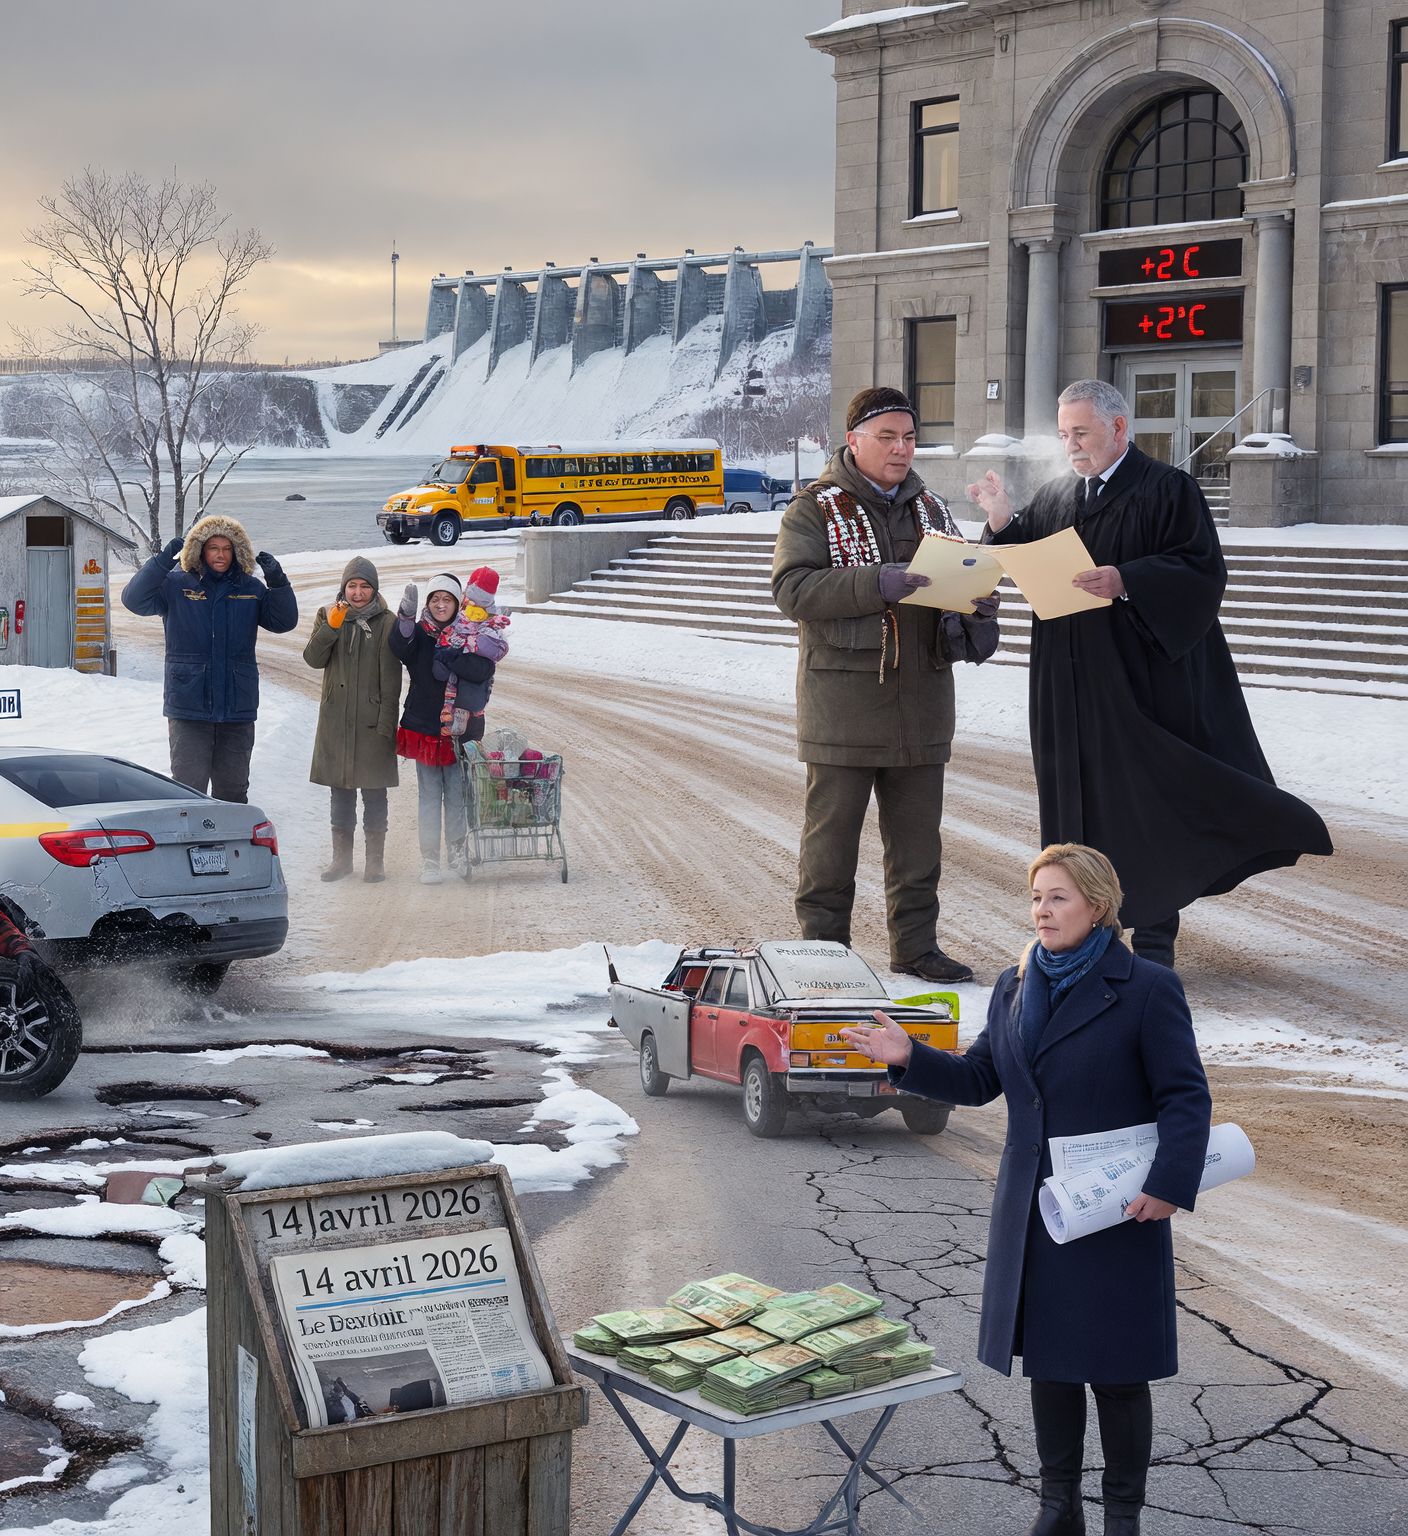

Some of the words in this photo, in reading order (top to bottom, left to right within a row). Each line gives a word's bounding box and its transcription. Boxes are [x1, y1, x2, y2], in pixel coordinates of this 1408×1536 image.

[1141, 248, 1175, 279] +2
[1138, 303, 1207, 339] +2°C
[262, 1205, 303, 1240] 14
[319, 1193, 396, 1232] avril
[402, 1184, 481, 1222] 2026
[296, 1266, 335, 1298] 14
[344, 1254, 417, 1292] avril
[422, 1243, 498, 1282] 2026
[298, 1318, 326, 1337] Le
